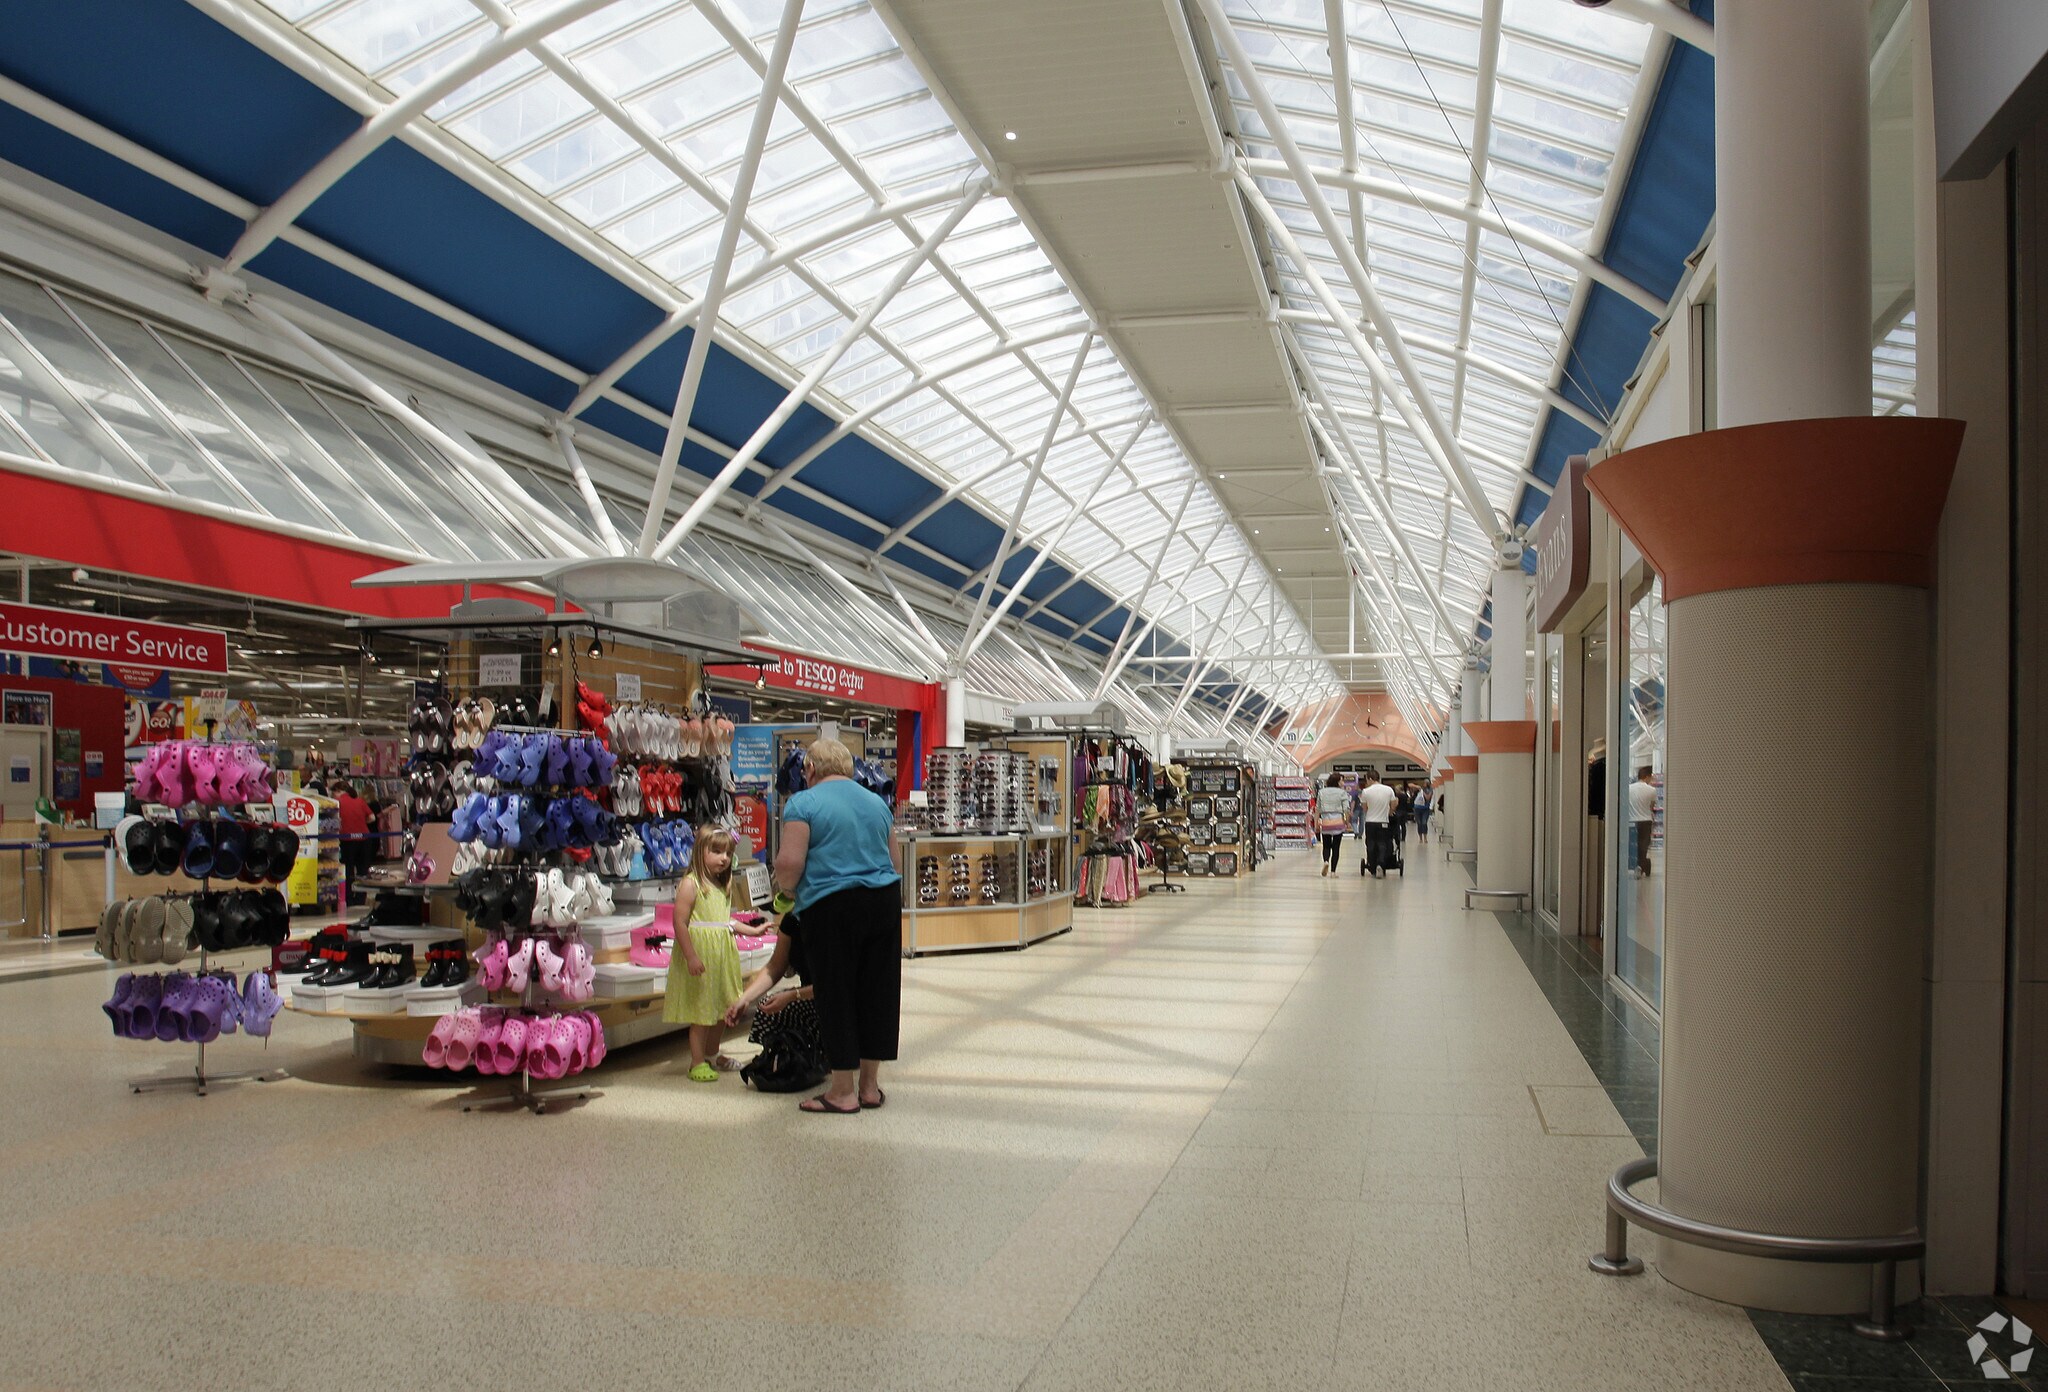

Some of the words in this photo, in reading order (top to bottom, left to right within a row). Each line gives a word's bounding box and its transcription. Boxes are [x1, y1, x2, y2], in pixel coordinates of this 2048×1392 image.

[1537, 514, 1567, 599] Evans
[126, 630, 209, 663] Service
[783, 658, 795, 677] to
[796, 658, 837, 685] TESCO
[838, 668, 864, 691] extra
[6, 694, 23, 702] Here
[33, 696, 49, 704] Help
[149, 716, 172, 729] GO!
[748, 742, 769, 750] monthly
[290, 799, 297, 808] 2
[287, 807, 312, 823] 30p
[743, 825, 760, 834] litre
